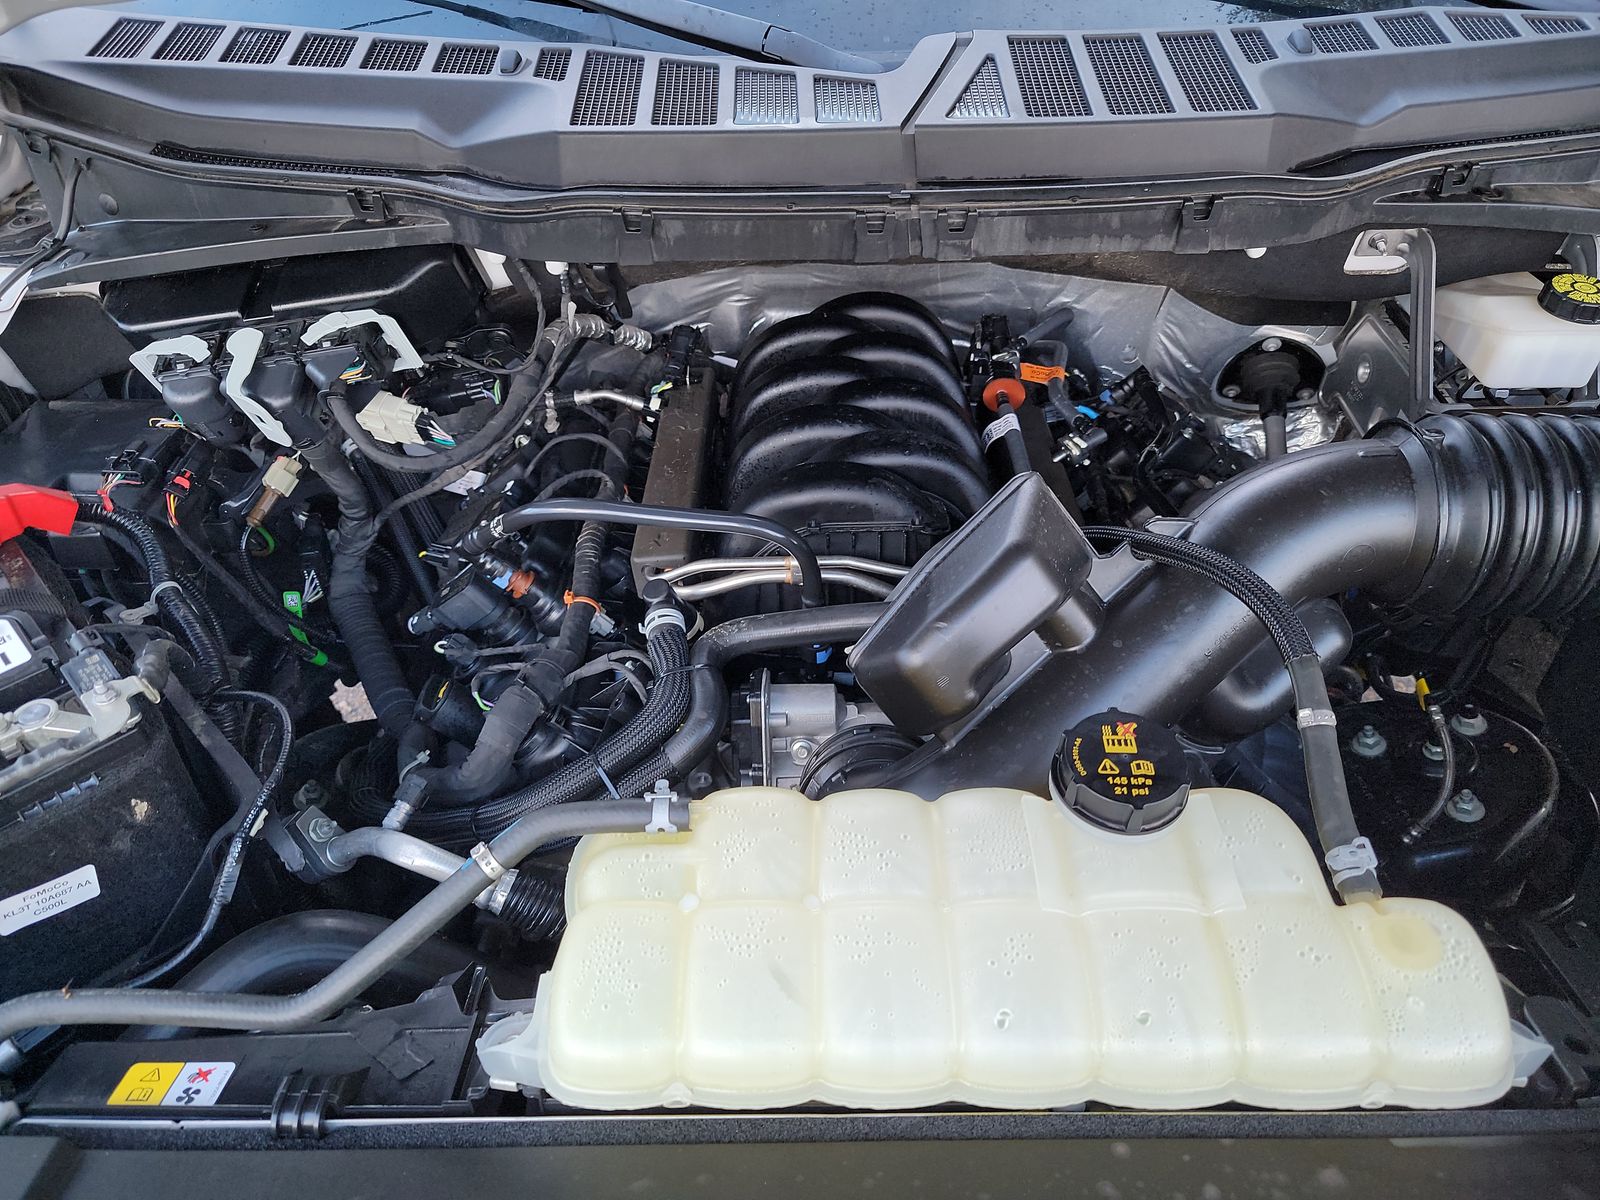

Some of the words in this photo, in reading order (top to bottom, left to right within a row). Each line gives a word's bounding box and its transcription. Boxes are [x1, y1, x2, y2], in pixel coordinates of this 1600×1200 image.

[1107, 776, 1128, 785] 145
[1130, 776, 1153, 786] kPa
[1114, 787, 1128, 795] 21
[1131, 787, 1150, 797] psi
[3, 903, 31, 919] KL3T
[76, 879, 92, 890] AA
[22, 880, 69, 903] FoMoCo
[33, 899, 68, 916] C500L
